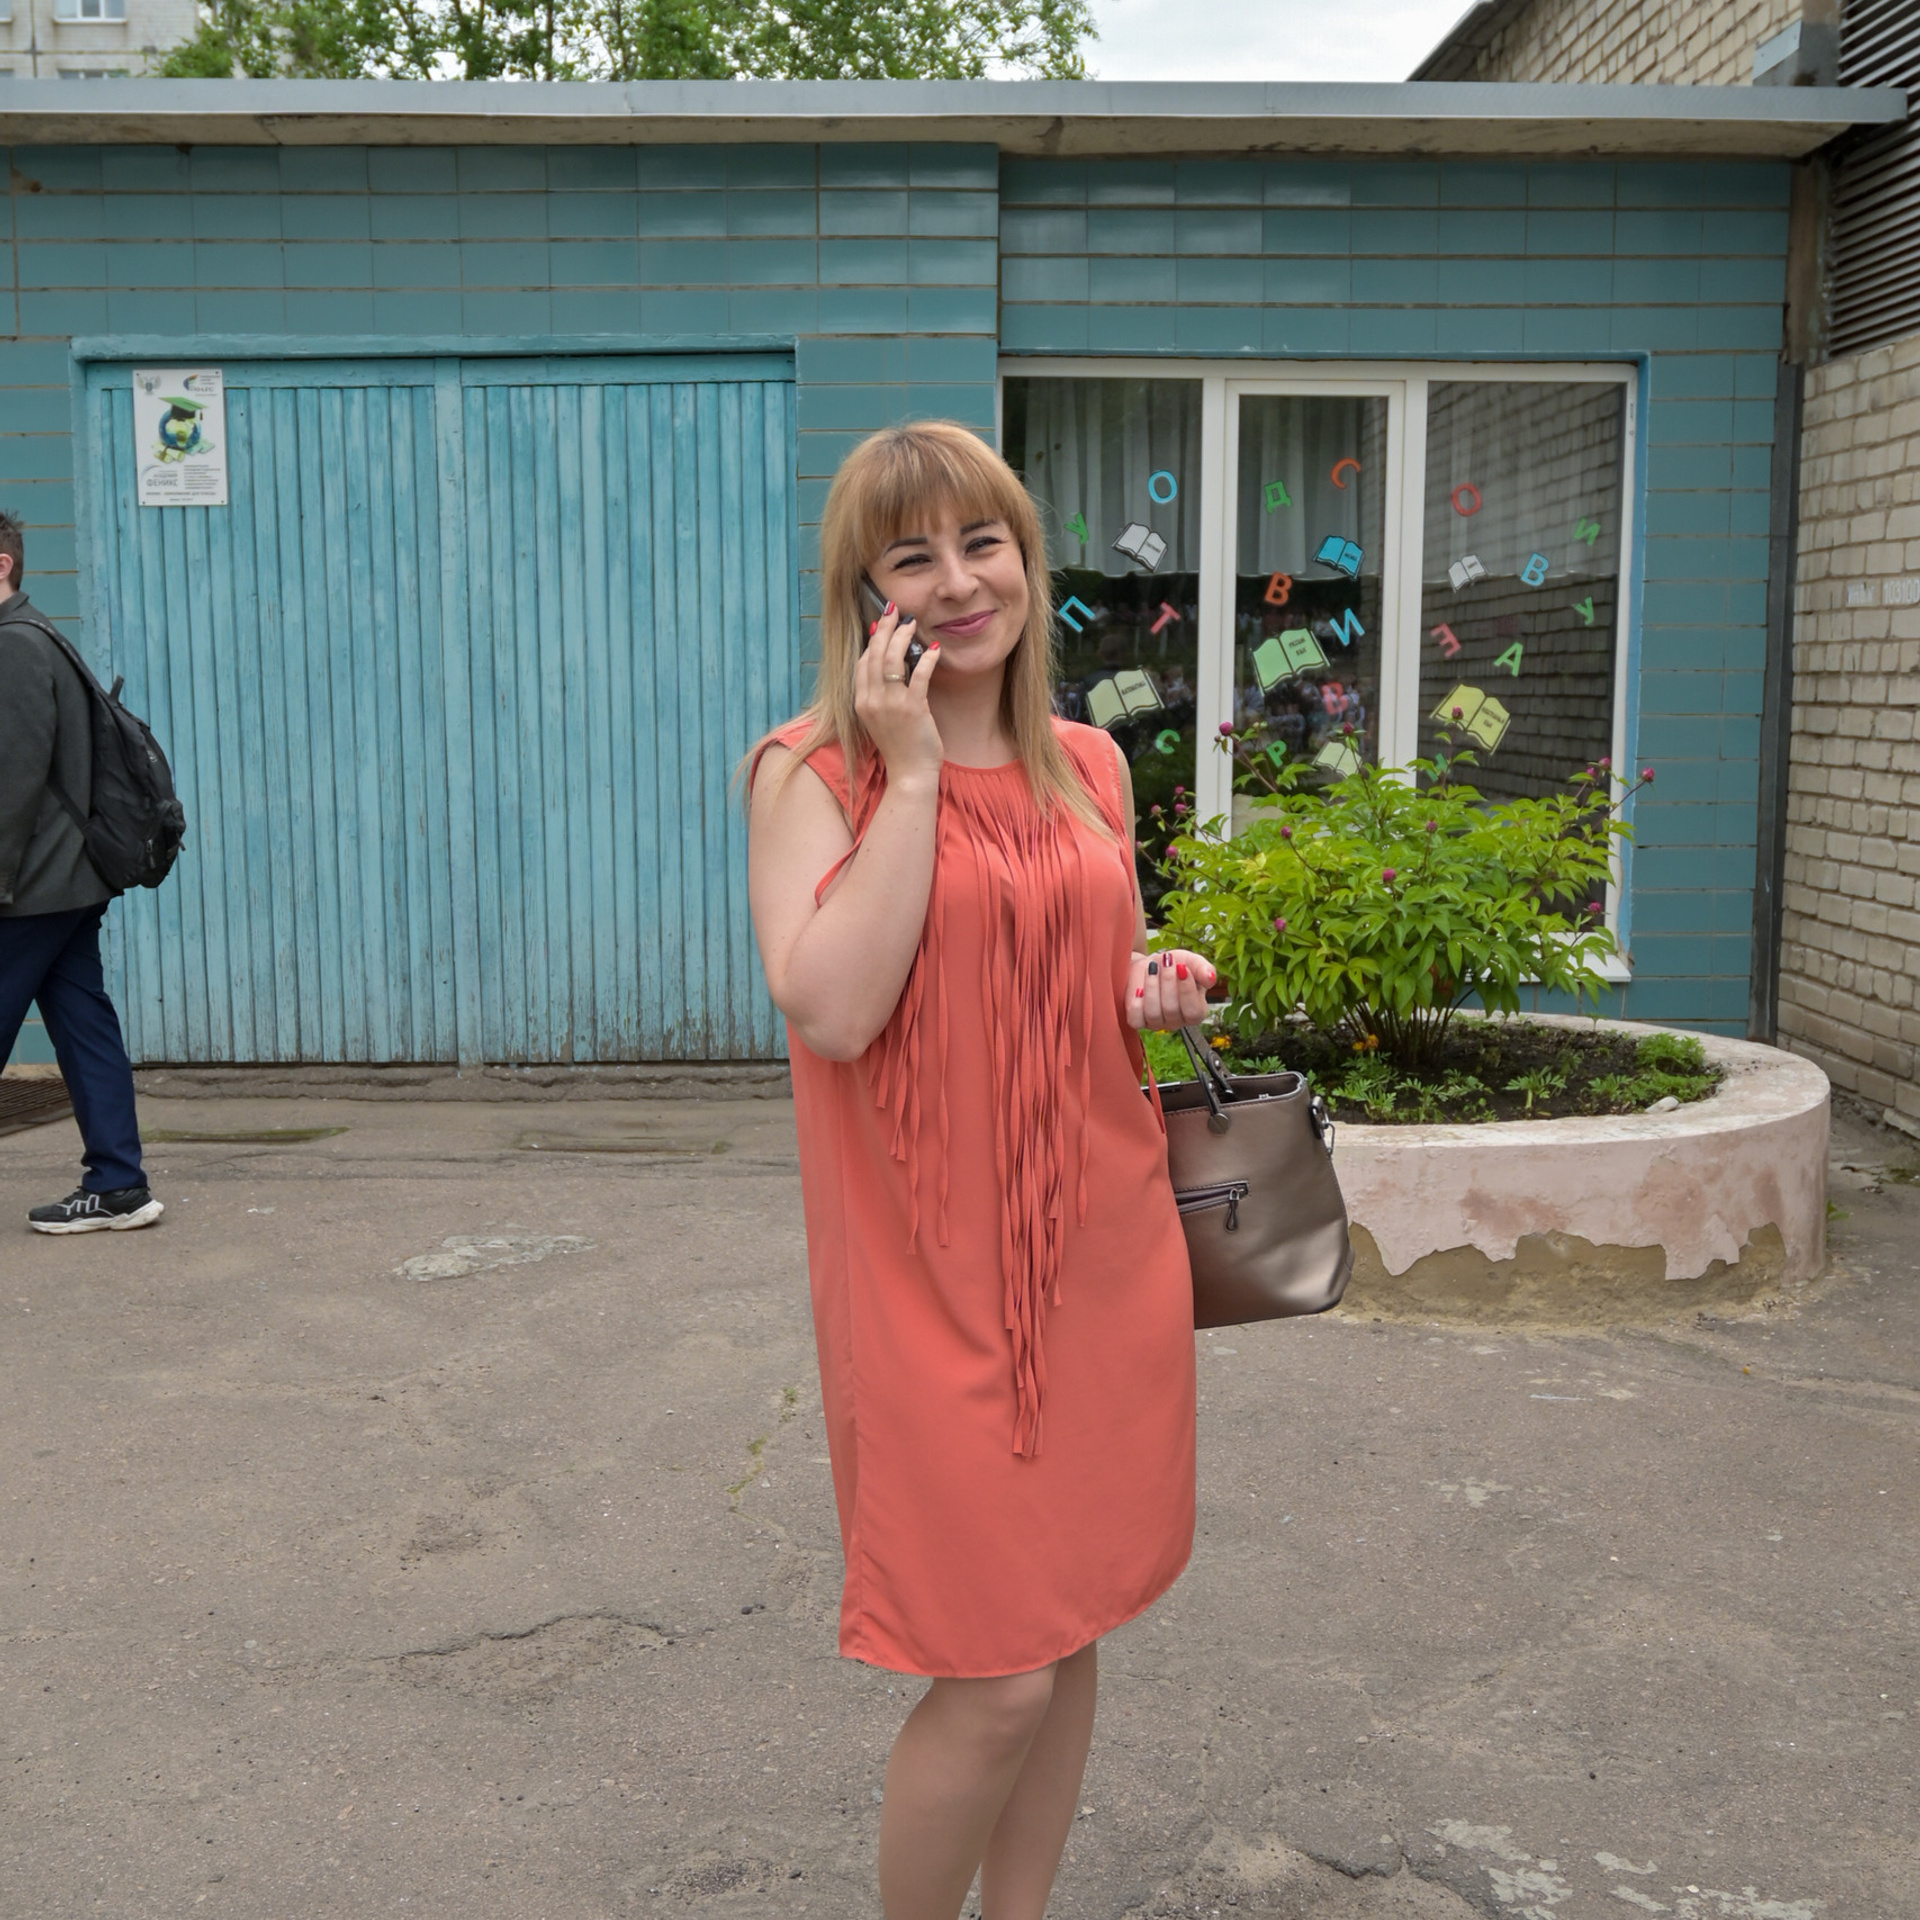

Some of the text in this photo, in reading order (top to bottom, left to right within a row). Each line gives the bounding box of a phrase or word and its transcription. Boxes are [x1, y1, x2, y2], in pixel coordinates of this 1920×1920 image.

[1148, 470, 1178, 504] О
[1331, 457, 1362, 489] С
[1263, 480, 1293, 514] Д
[1452, 483, 1482, 517] О
[1065, 512, 1089, 545] У
[1520, 553, 1549, 587] В
[1264, 571, 1293, 606] В
[1058, 595, 1096, 633] П
[1151, 601, 1181, 634] Т
[1329, 608, 1365, 646] И
[1572, 597, 1594, 626] У
[1493, 642, 1524, 677] А
[1155, 729, 1180, 754] С
[1266, 740, 1287, 767] Р
